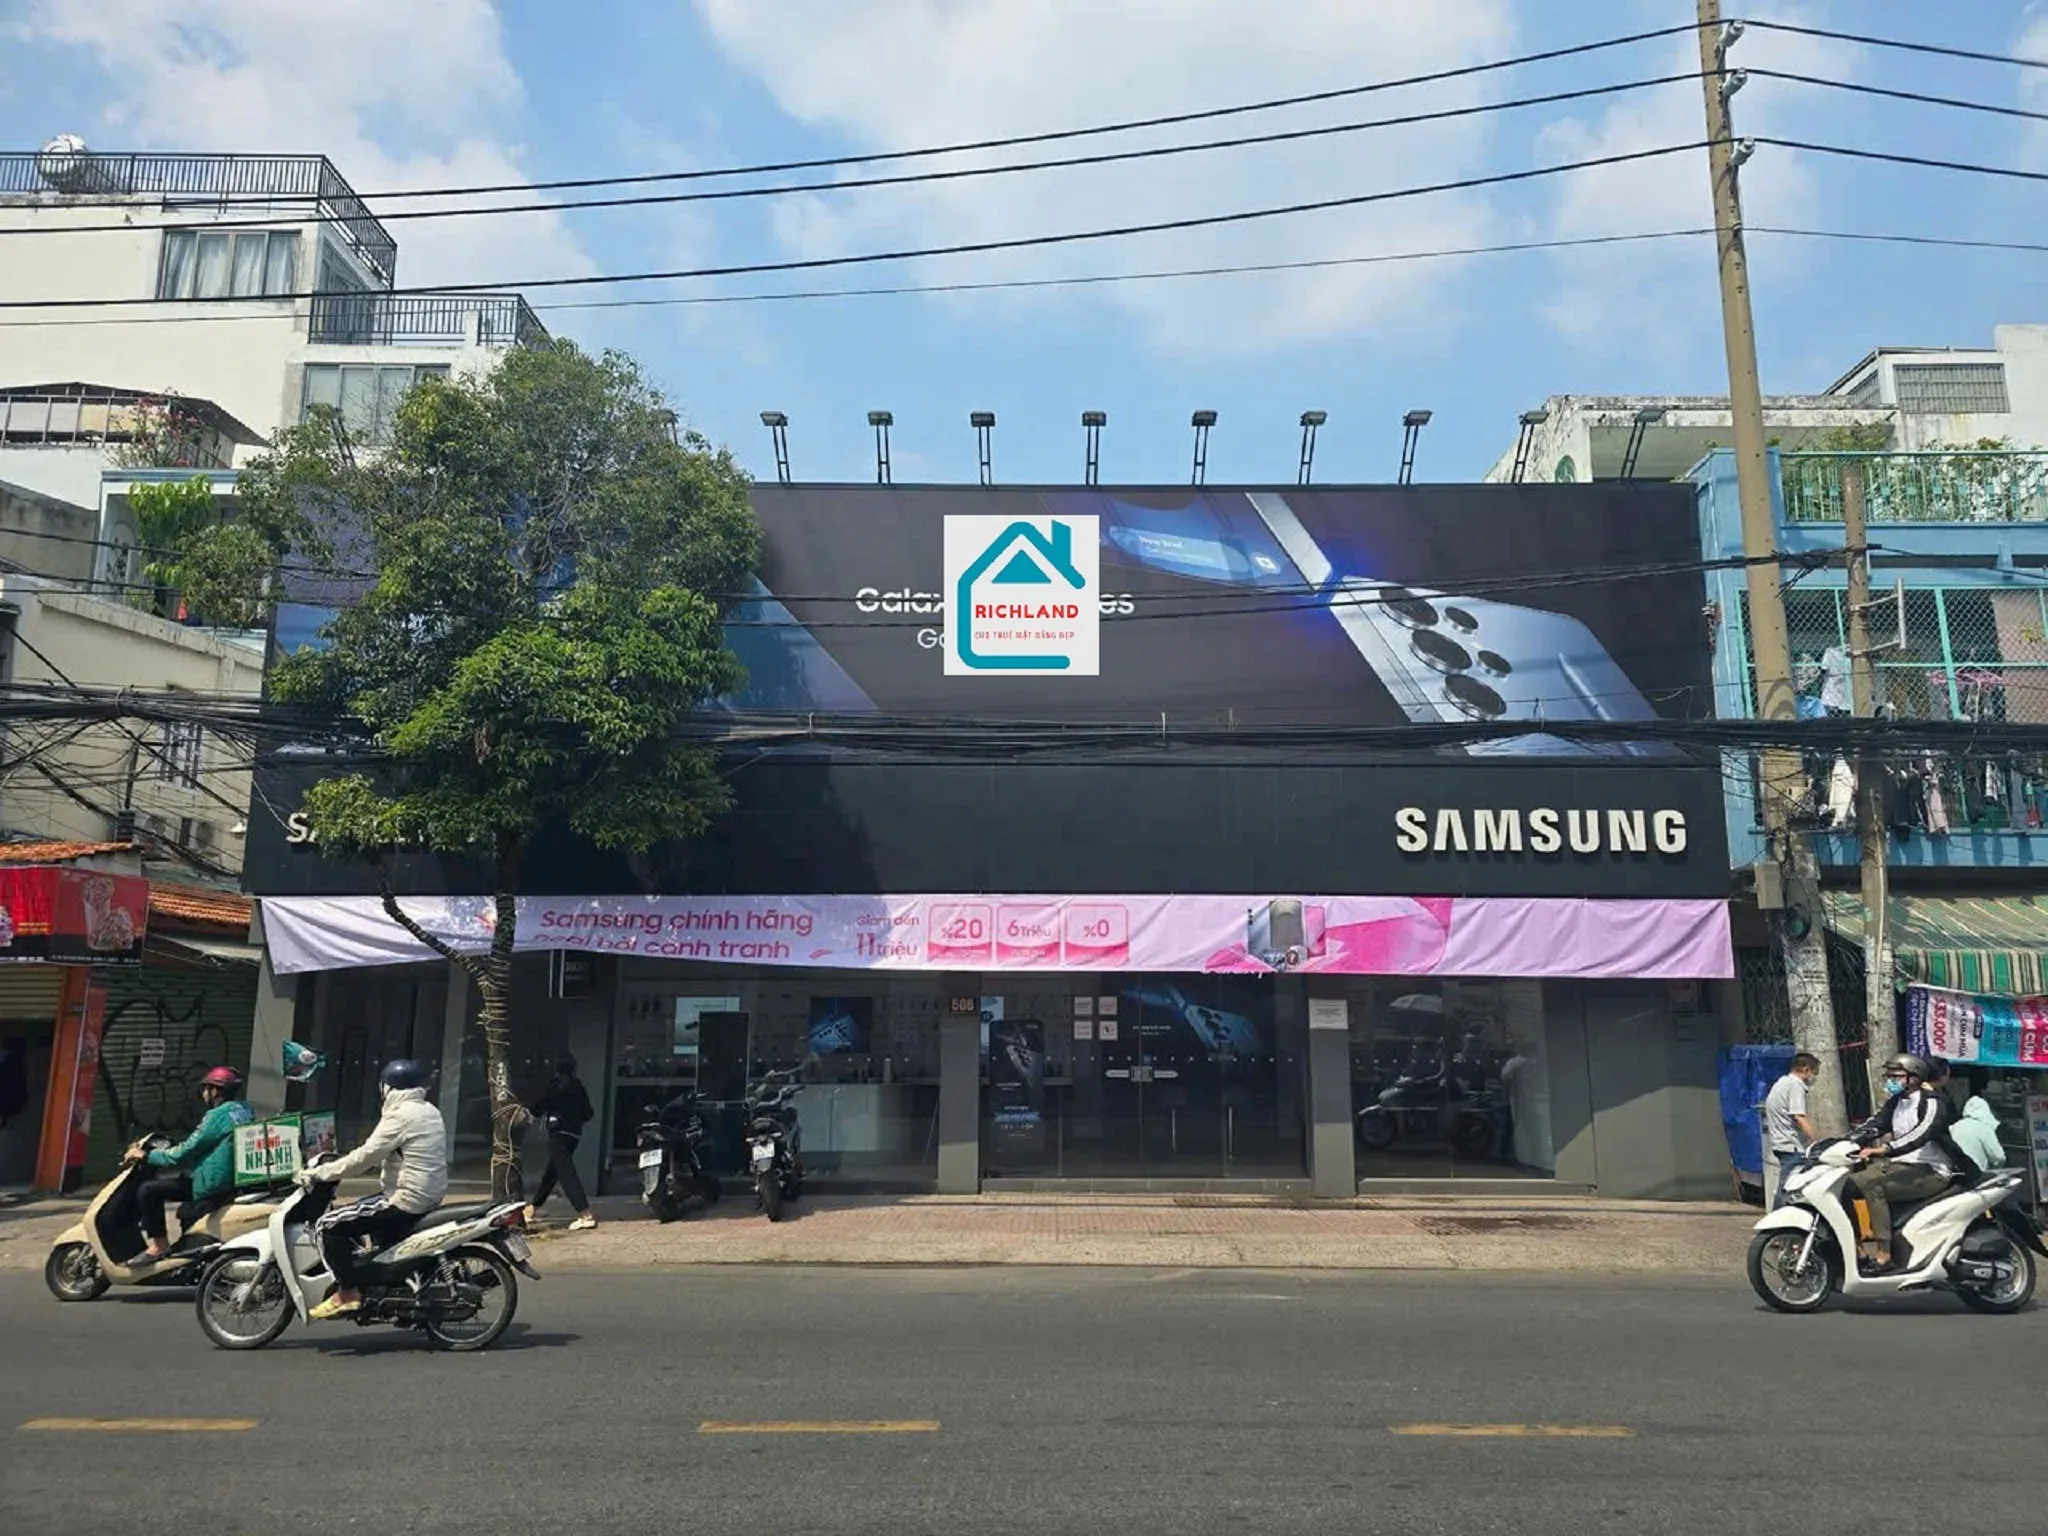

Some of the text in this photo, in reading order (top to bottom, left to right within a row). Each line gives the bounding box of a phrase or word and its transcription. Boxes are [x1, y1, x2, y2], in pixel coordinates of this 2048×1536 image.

[1395, 807, 1688, 854] SAMSUNG
[540, 909, 814, 937] Samsung chính hãng
[941, 918, 985, 939] %20
[1083, 918, 1111, 938] %0
[719, 939, 790, 959] tranh
